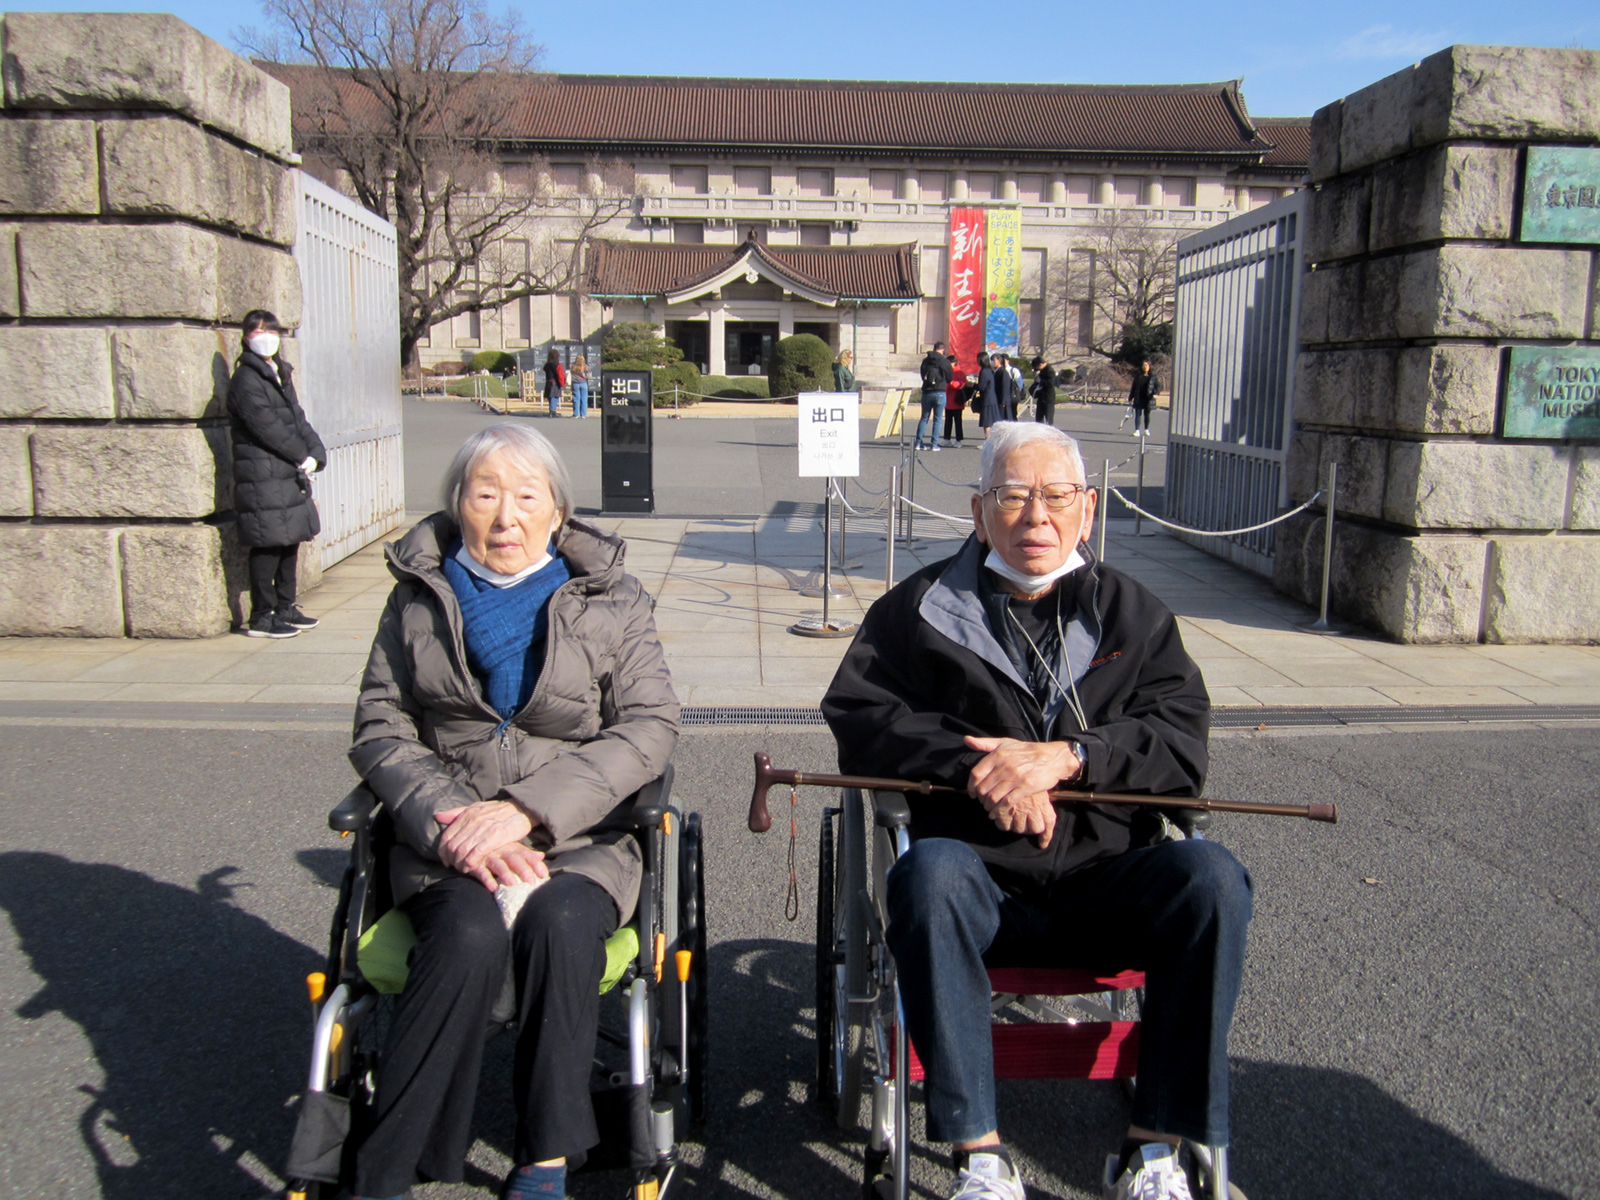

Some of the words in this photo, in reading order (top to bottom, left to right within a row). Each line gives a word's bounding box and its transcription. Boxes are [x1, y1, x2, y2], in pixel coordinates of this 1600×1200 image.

[991, 212, 1012, 220] PLAY
[991, 221, 1018, 229] SPACE
[611, 377, 641, 394] 出口
[611, 397, 629, 406] Exit
[812, 407, 844, 423] 出口
[820, 429, 838, 438] Exit
